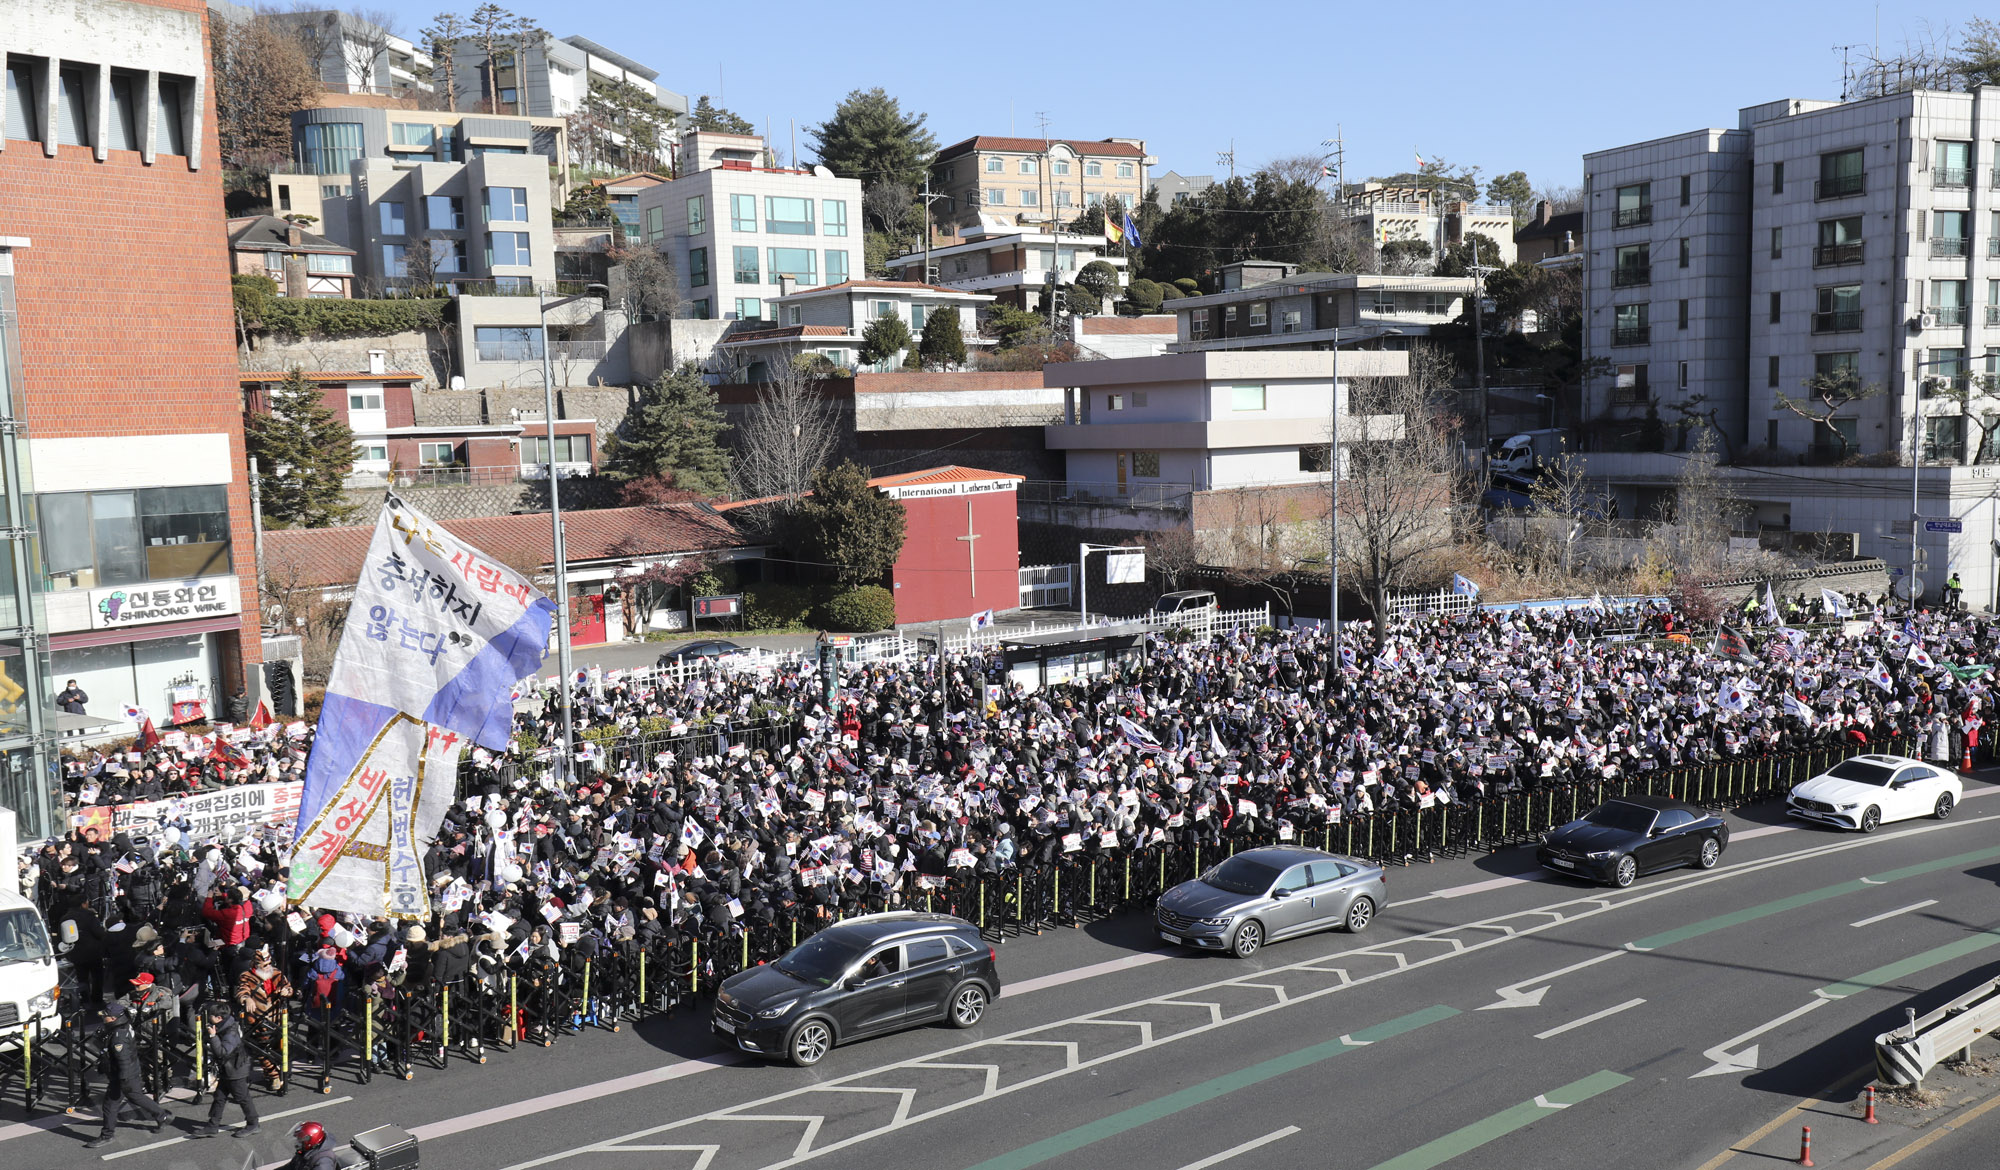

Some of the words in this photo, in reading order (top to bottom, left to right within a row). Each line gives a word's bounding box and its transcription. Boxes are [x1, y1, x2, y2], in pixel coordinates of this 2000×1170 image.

[898, 484, 956, 498] International
[961, 482, 991, 494] Lutheran
[992, 480, 1013, 490] Church
[129, 584, 217, 609] 신동와인
[376, 551, 483, 626] 충성하지
[450, 551, 532, 610] 사람에
[120, 605, 190, 622] SHINDONG
[193, 601, 228, 613] WINE
[391, 775, 422, 914] 헌법수호
